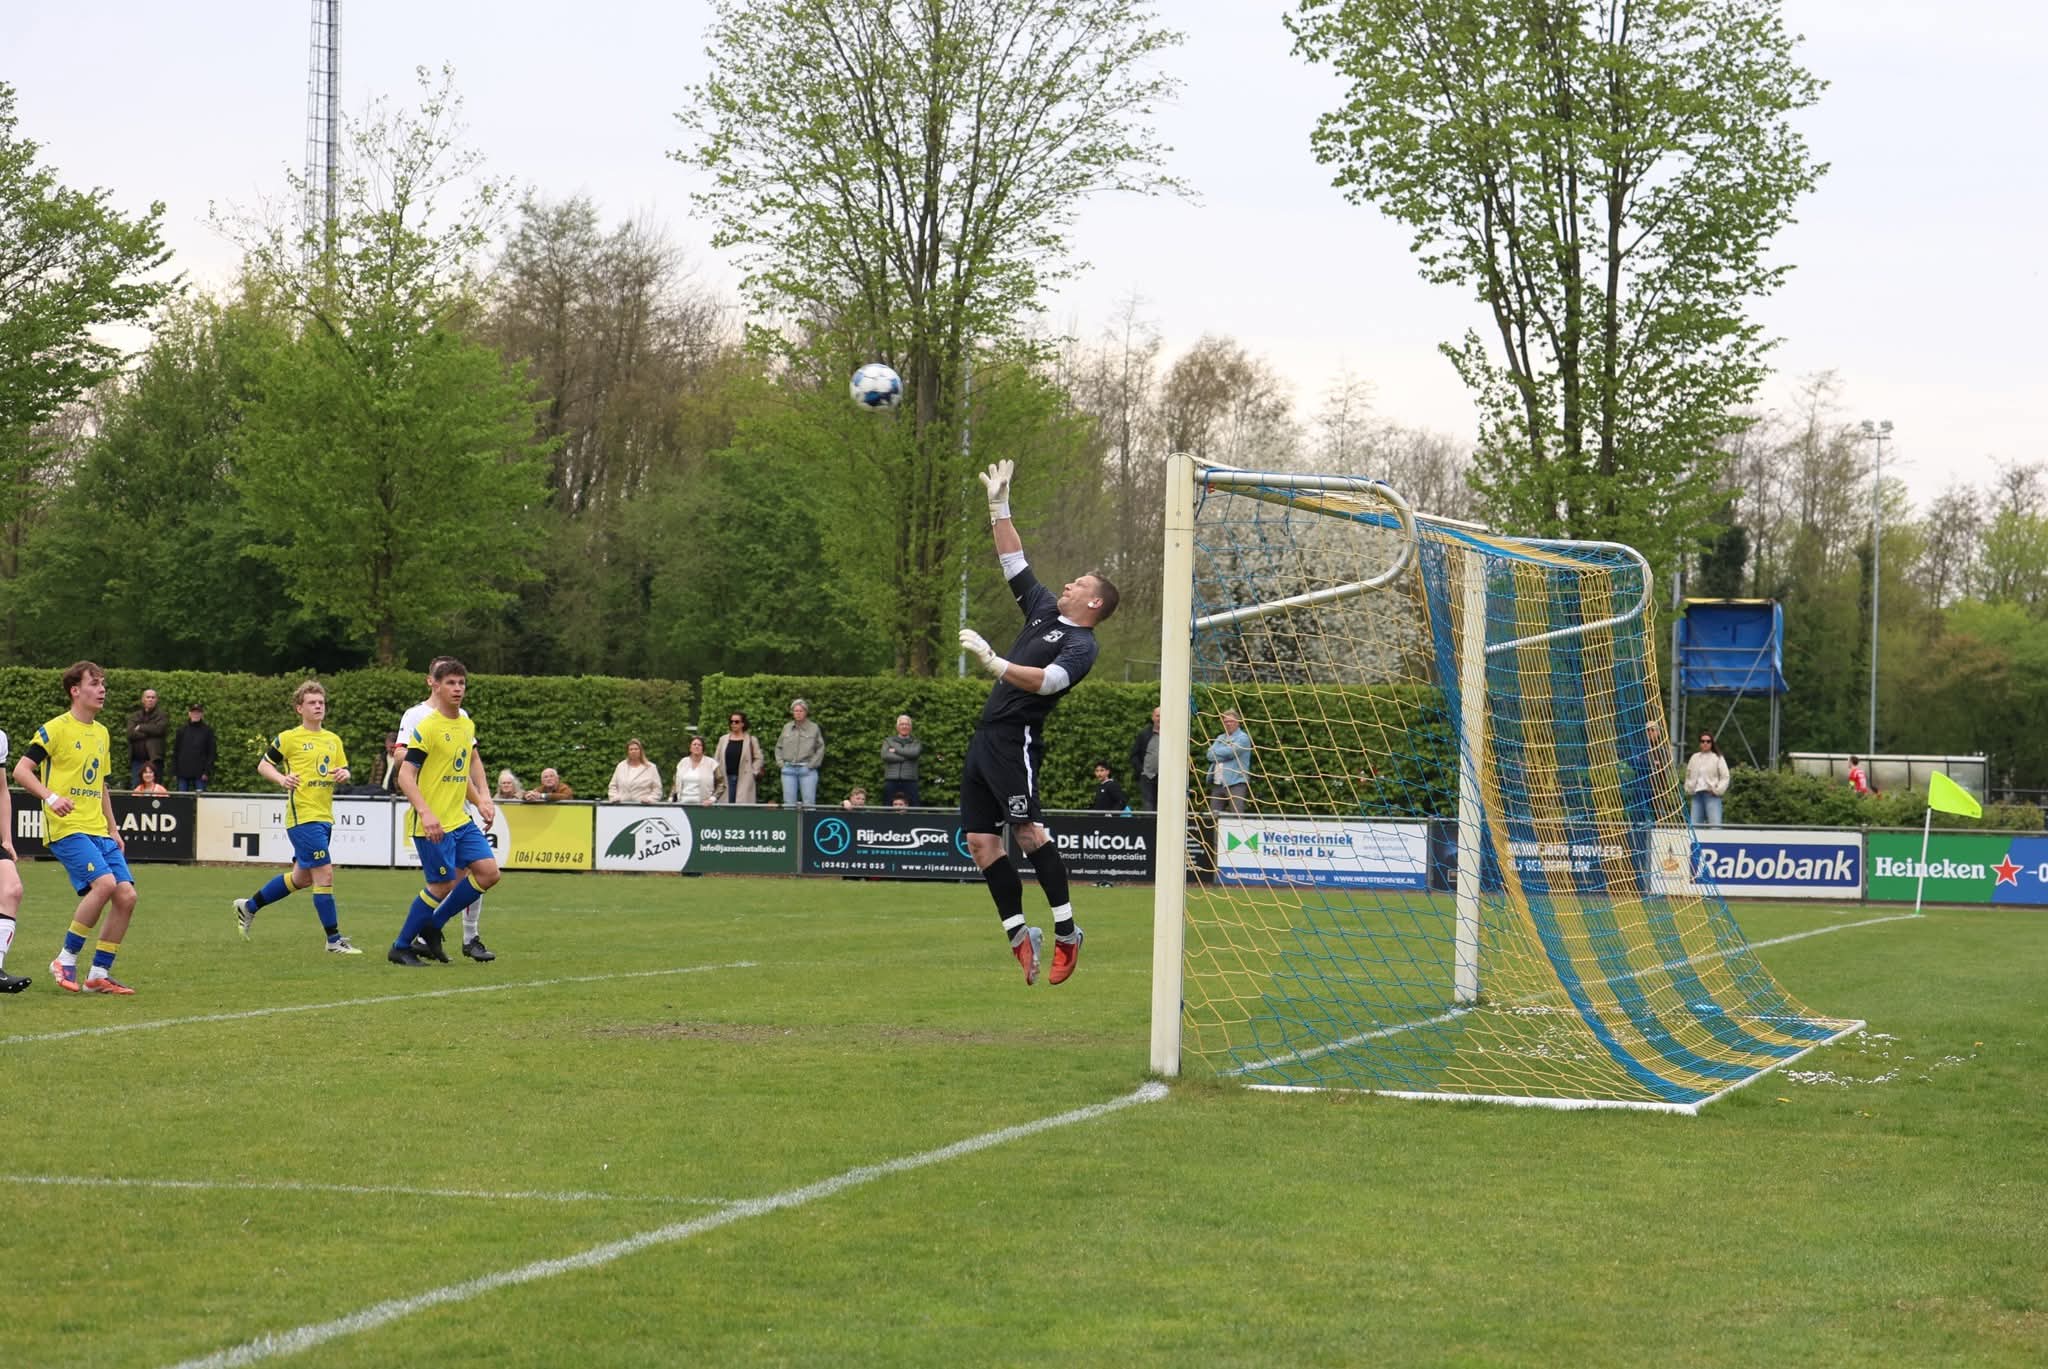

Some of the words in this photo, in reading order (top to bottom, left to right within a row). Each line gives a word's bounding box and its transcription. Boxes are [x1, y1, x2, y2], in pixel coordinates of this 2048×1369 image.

[75, 741, 82, 750] 4
[700, 829, 721, 840] (06)
[724, 829, 745, 840] 523
[749, 830, 768, 840] 111
[772, 830, 786, 840] 80
[856, 828, 949, 847] RijndersSport
[1263, 832, 1353, 845] Weegtechniek
[1057, 834, 1079, 849] DE
[637, 837, 681, 861] JAZON
[1263, 845, 1313, 857] holland
[313, 851, 326, 860] 20
[1083, 852, 1106, 860] home
[1108, 853, 1146, 861] specialist
[87, 862, 95, 872] 4
[1697, 848, 1854, 881] Rabobank
[1875, 857, 1986, 879] Heineken
